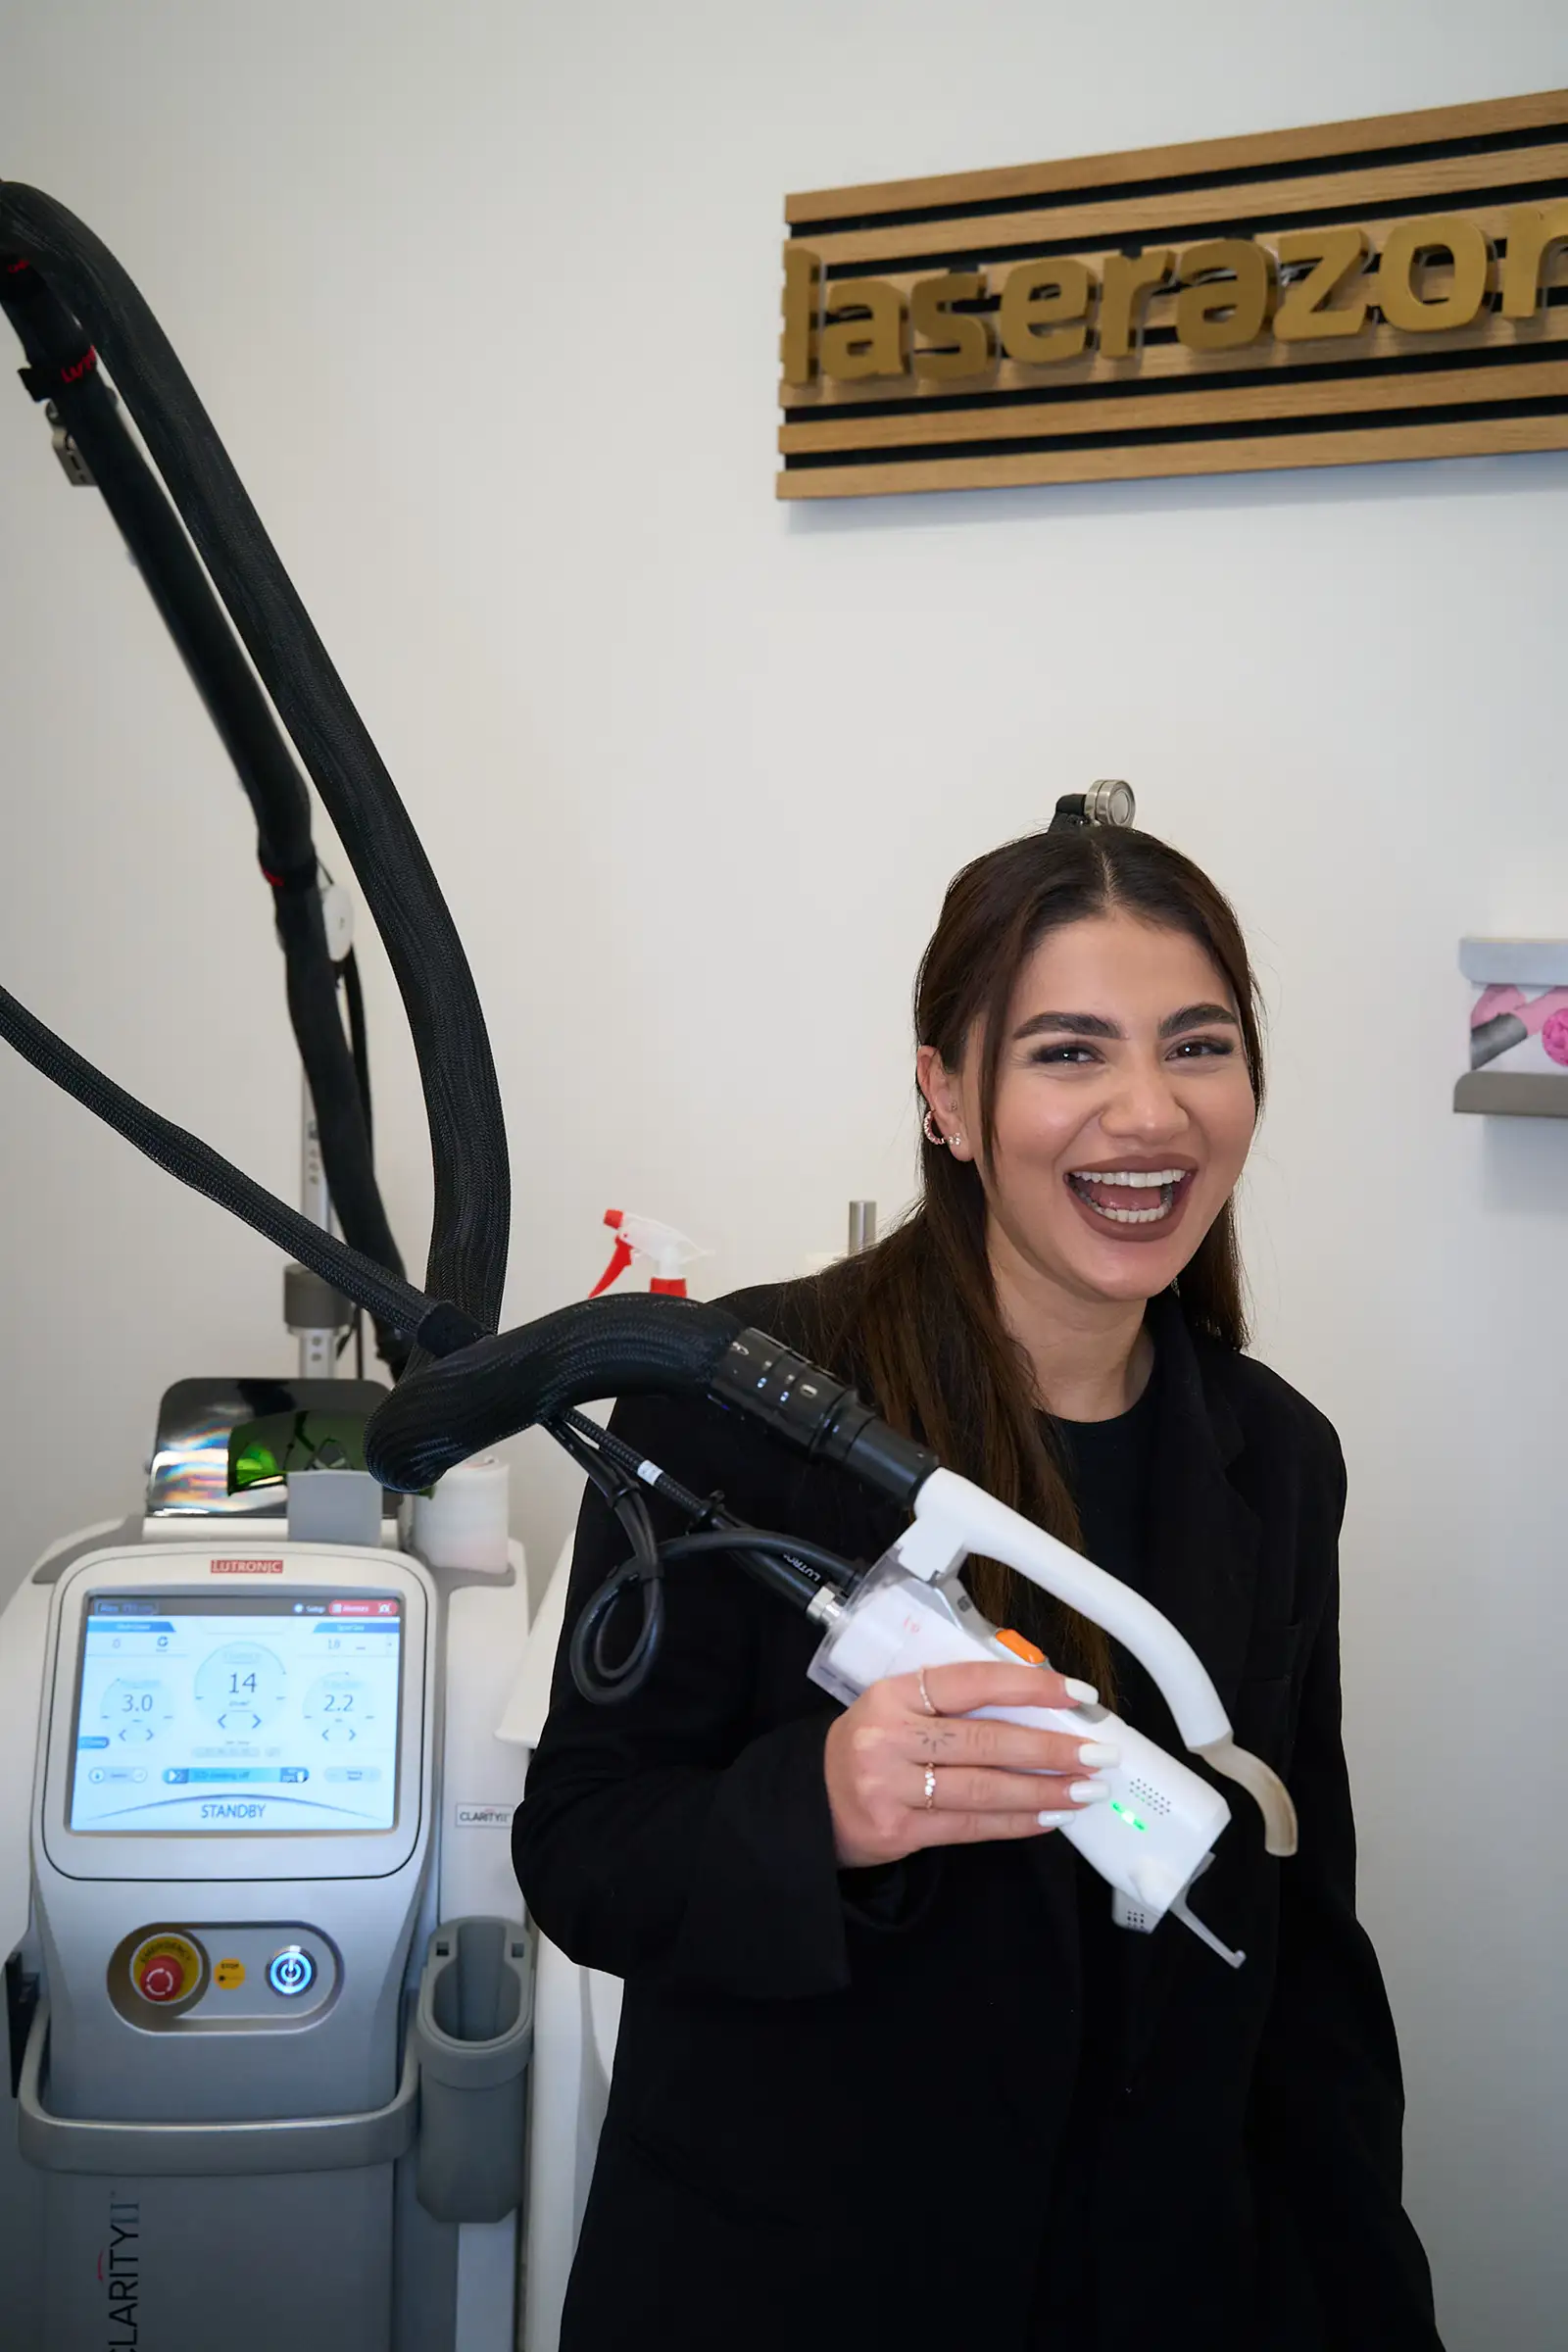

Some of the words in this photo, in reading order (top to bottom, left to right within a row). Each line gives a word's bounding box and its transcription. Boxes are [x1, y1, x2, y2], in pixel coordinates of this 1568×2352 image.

[783, 202, 1568, 384] laserazor
[212, 1560, 281, 1574] LUTRONIC
[228, 1672, 258, 1693] 14
[122, 1694, 154, 1713] 3.0
[322, 1693, 355, 1712] 2.2
[201, 1804, 266, 1819] STANDBY
